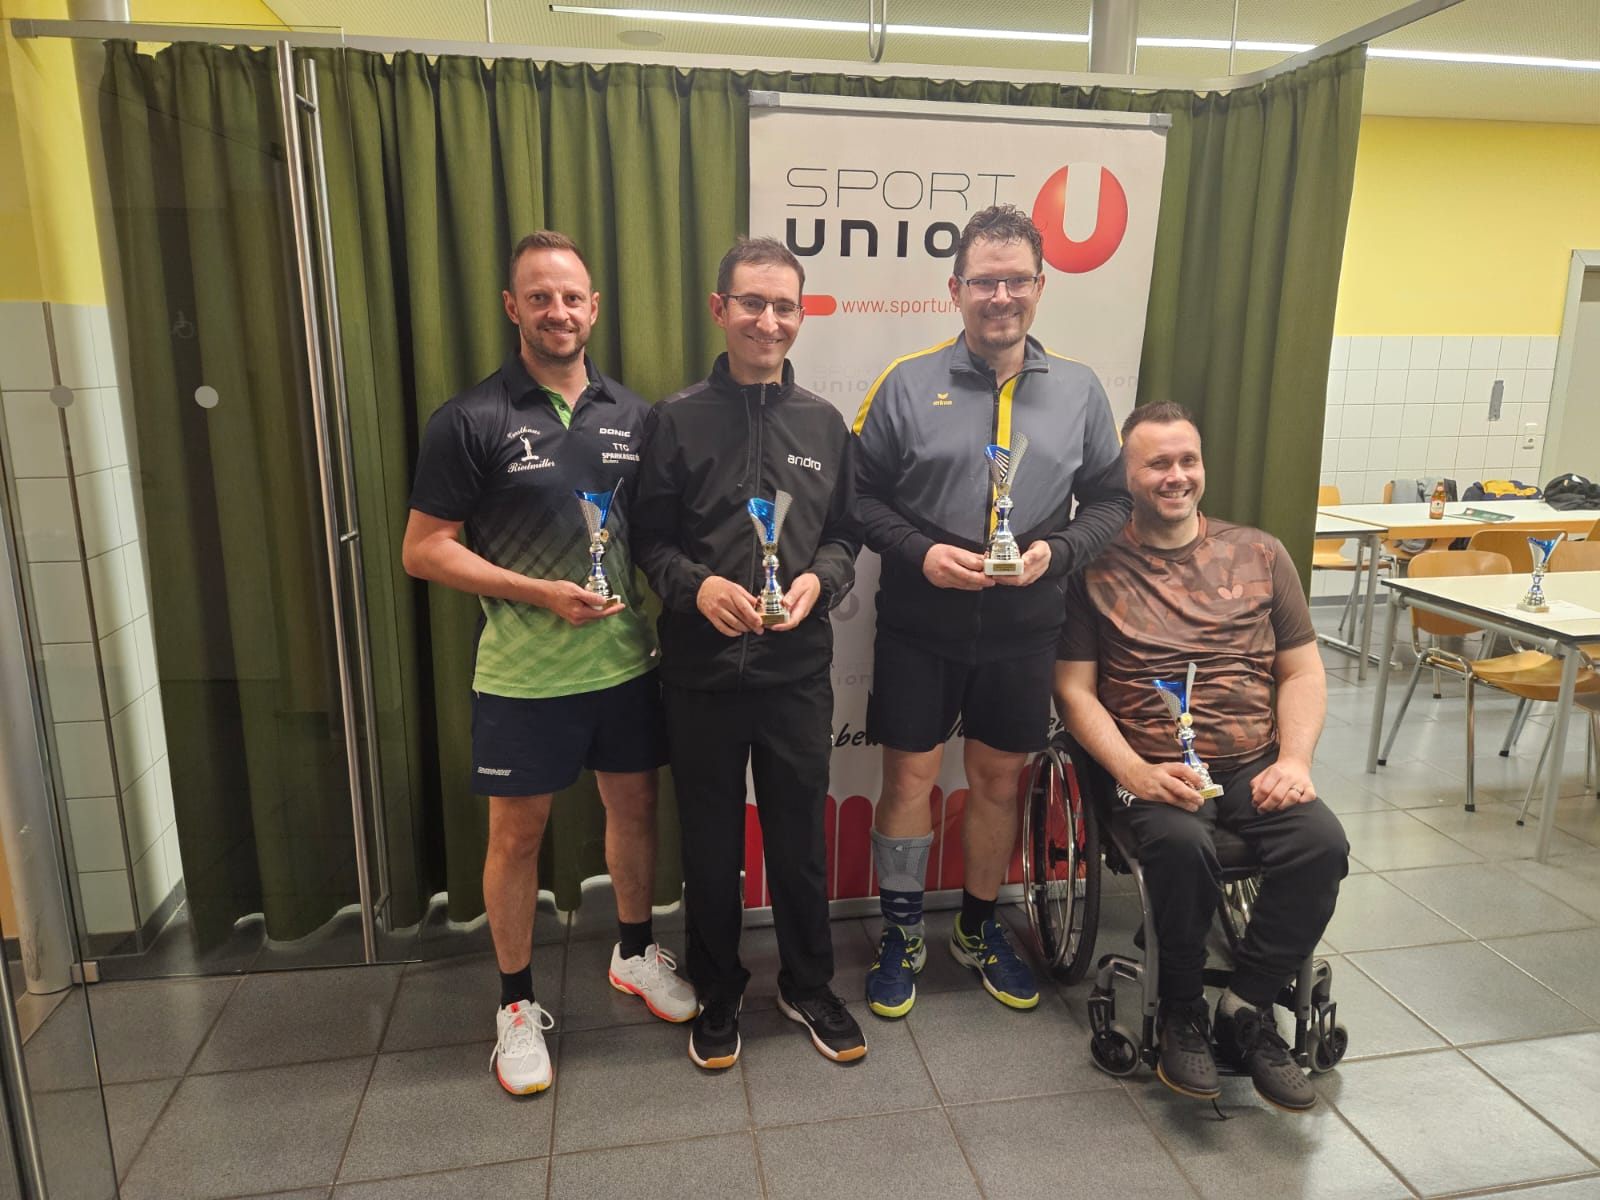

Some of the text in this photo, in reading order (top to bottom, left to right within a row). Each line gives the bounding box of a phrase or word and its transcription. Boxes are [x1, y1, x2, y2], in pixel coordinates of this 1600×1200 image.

[785, 166, 1016, 210] SPORT
[841, 297, 960, 318] www.sportun
[599, 427, 632, 438] DONIC
[611, 442, 631, 452] TTC
[787, 453, 822, 471] andro
